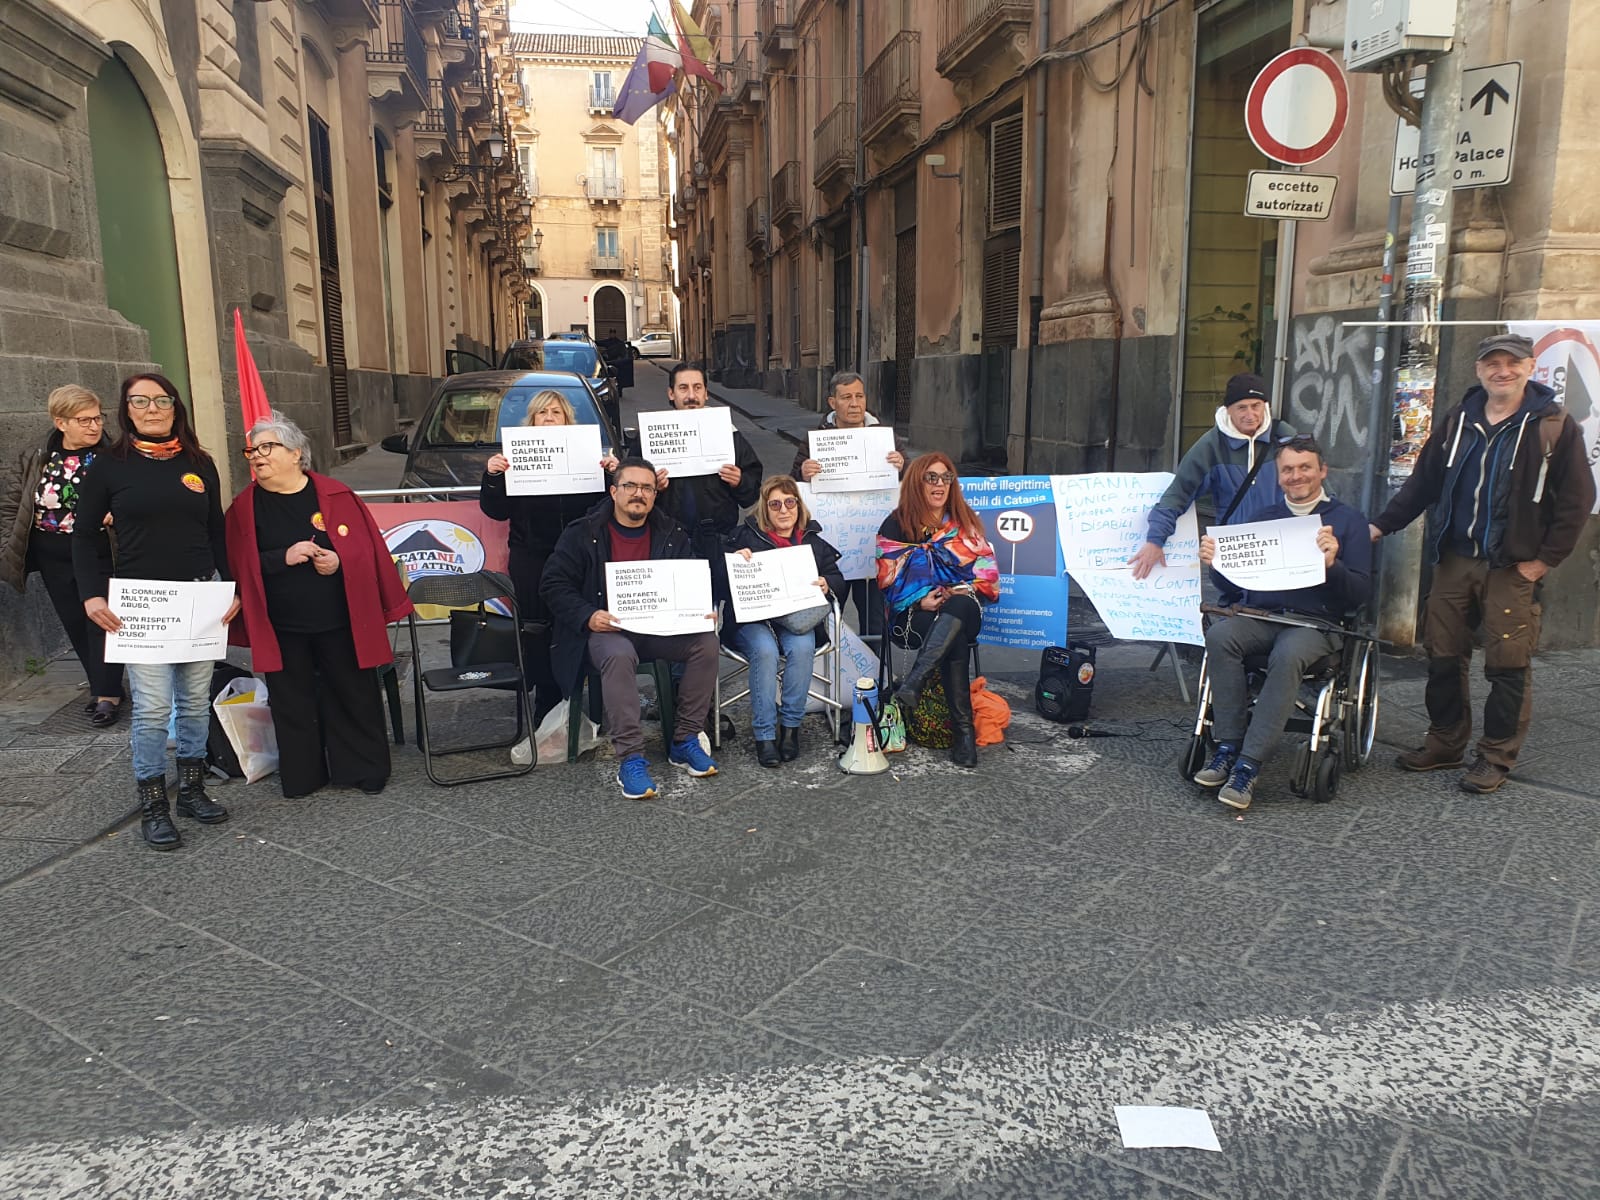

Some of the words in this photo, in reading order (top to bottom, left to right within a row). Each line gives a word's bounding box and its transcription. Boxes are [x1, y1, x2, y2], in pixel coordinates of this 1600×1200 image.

[1470, 169, 1485, 179] m.
[1268, 182, 1319, 193] eccetto
[1256, 200, 1324, 212] autorizzati
[648, 424, 680, 432] DIRITTI
[648, 430, 697, 439] CALPESTATI
[650, 439, 686, 447] DISABILI
[511, 447, 564, 455] CALPESTATI
[650, 446, 688, 455] MULTATI!
[967, 480, 997, 491] multe
[1000, 480, 1051, 493] illegittime
[1059, 477, 1142, 495] CATANIA
[966, 496, 988, 506] abili
[991, 496, 1001, 506] di
[1004, 495, 1046, 506] Catania
[1000, 518, 1029, 532] ZTL
[1081, 520, 1133, 533] DISABILI
[1218, 533, 1256, 544] DIRITTI
[1220, 539, 1279, 553] CALPESTATI
[398, 551, 465, 564] CATANIA
[1221, 550, 1264, 561] DISABILI
[421, 562, 464, 573] ATTIVA
[1221, 558, 1266, 569] MULTATI!
[1154, 575, 1198, 590] CONTI
[120, 602, 151, 610] ABUSO,
[618, 604, 658, 612] CONFLITTO!
[1000, 607, 1053, 616] incatenamento
[998, 617, 1023, 625] parenti
[1001, 627, 1046, 637] associazioni,
